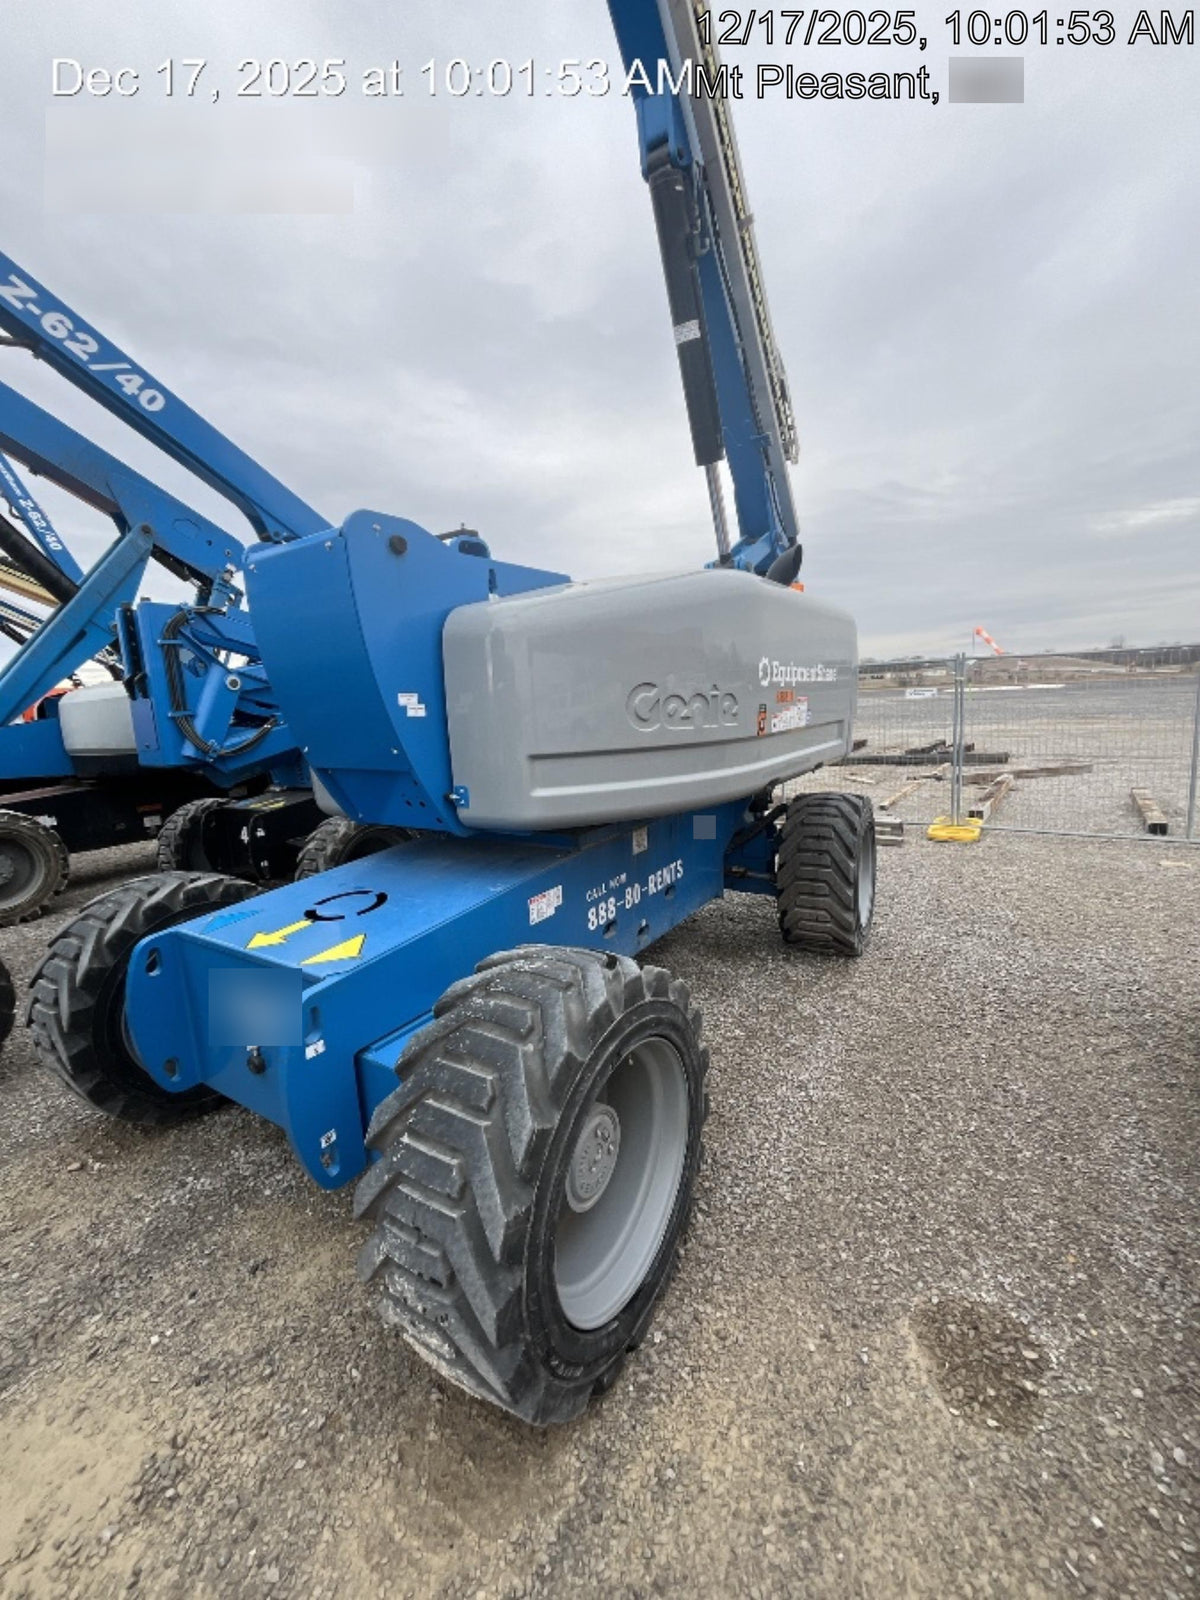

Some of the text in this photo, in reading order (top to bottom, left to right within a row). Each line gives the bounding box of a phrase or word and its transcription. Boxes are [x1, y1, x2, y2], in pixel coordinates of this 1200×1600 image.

[0, 274, 166, 412] Z-62/40
[626, 681, 739, 732] Genie
[586, 883, 607, 902] CALL
[588, 858, 684, 931] 888-80-RENTS
